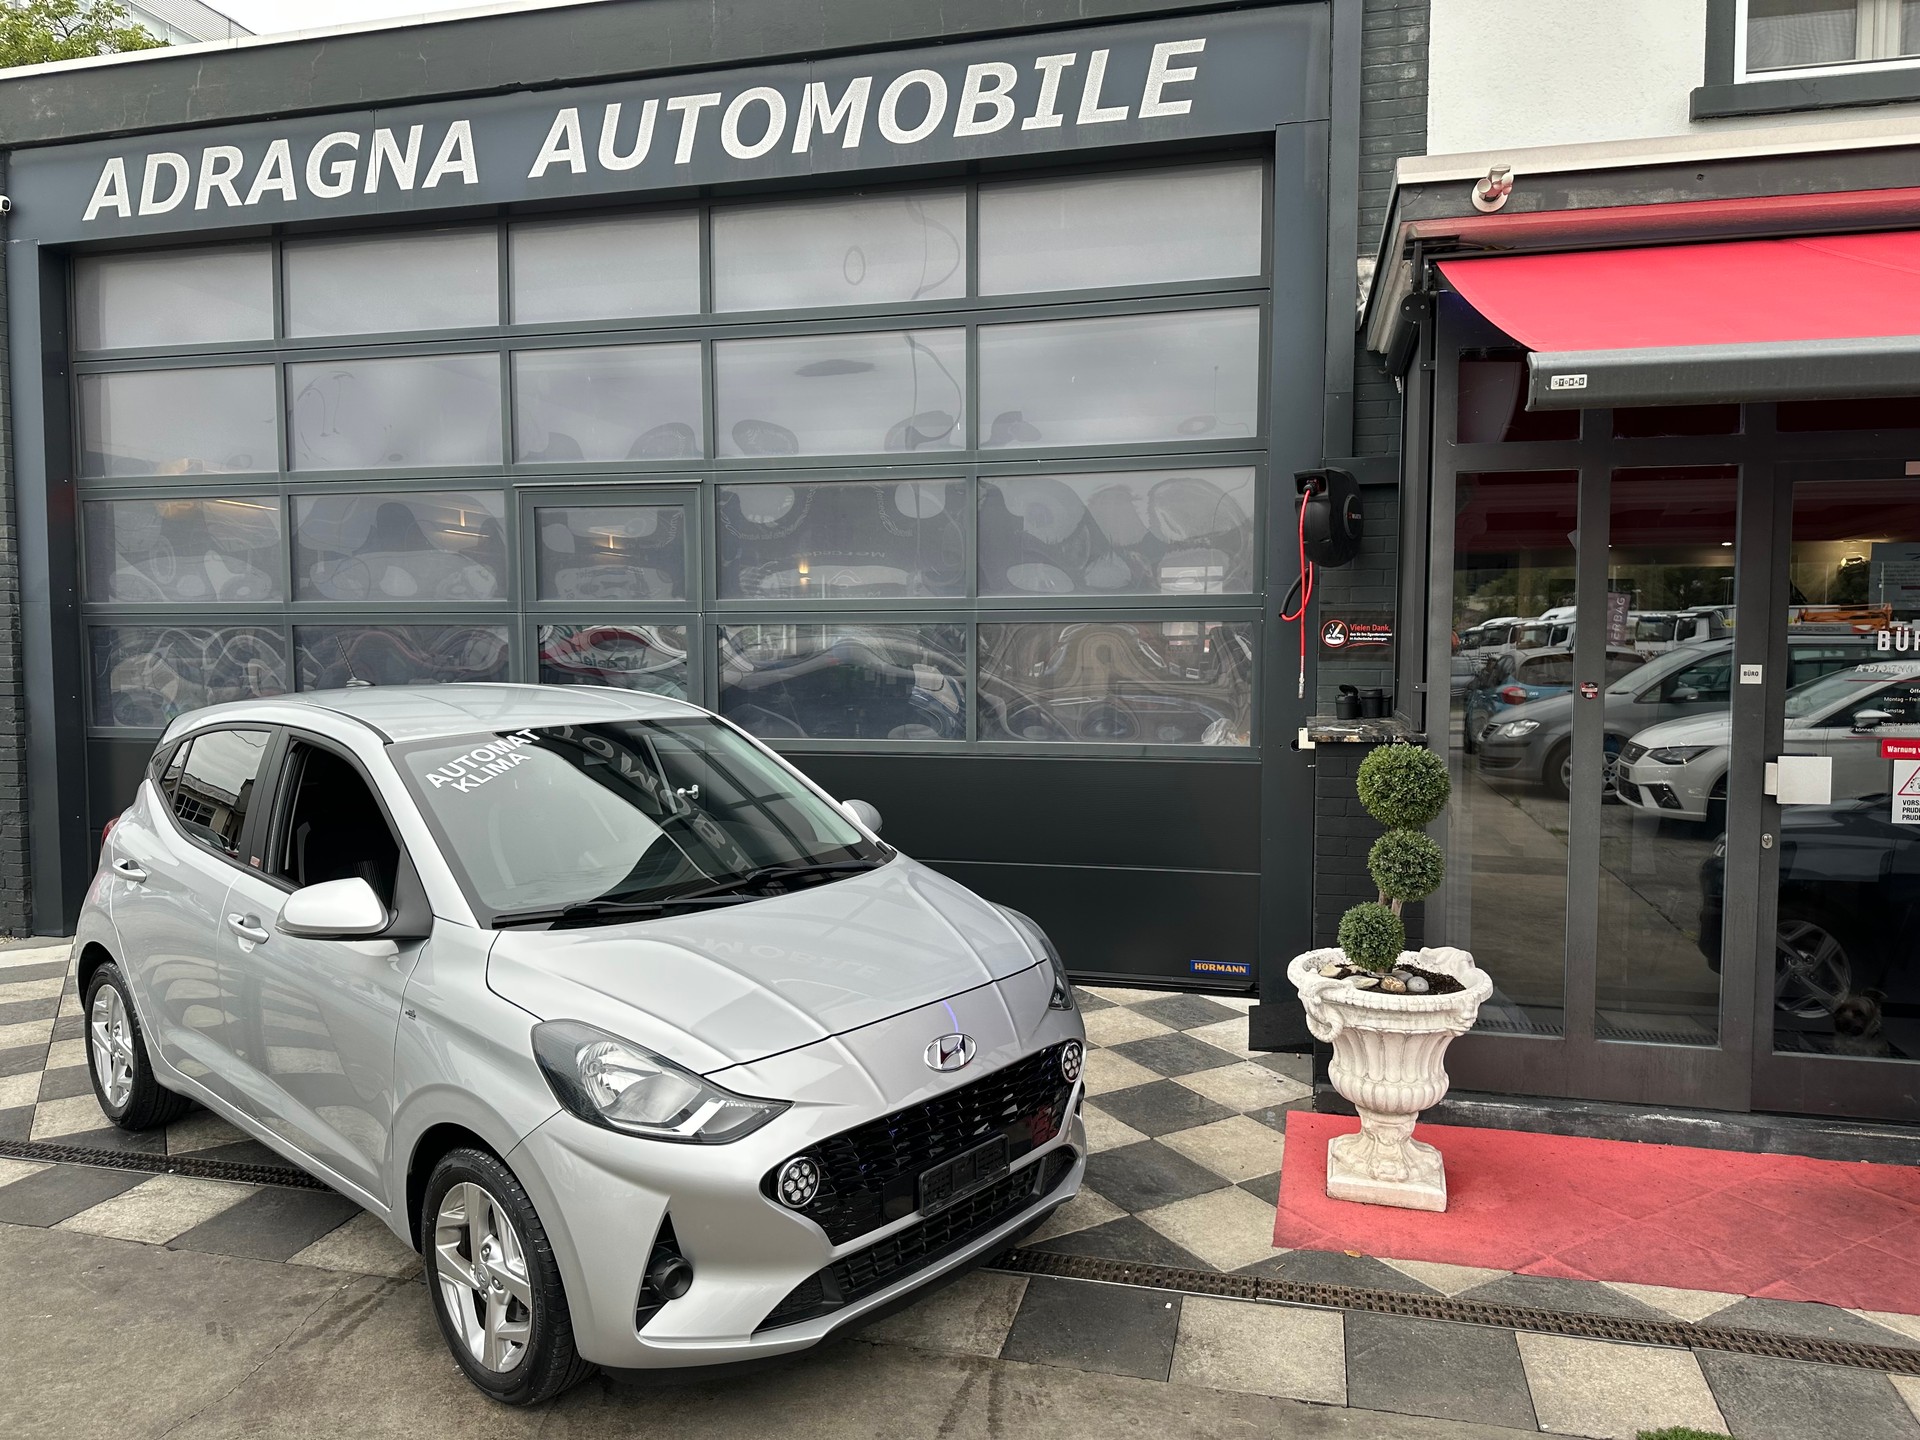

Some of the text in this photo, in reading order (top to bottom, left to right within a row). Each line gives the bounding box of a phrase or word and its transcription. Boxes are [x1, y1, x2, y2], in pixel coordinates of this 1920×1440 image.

[82, 38, 1207, 221] ADRAGNA AUTOMOBILE
[1743, 669, 1759, 677] BÜRO
[425, 727, 541, 789] AUTOMAT
[1886, 745, 1916, 754] Warnung
[450, 753, 531, 794] KLIMA
